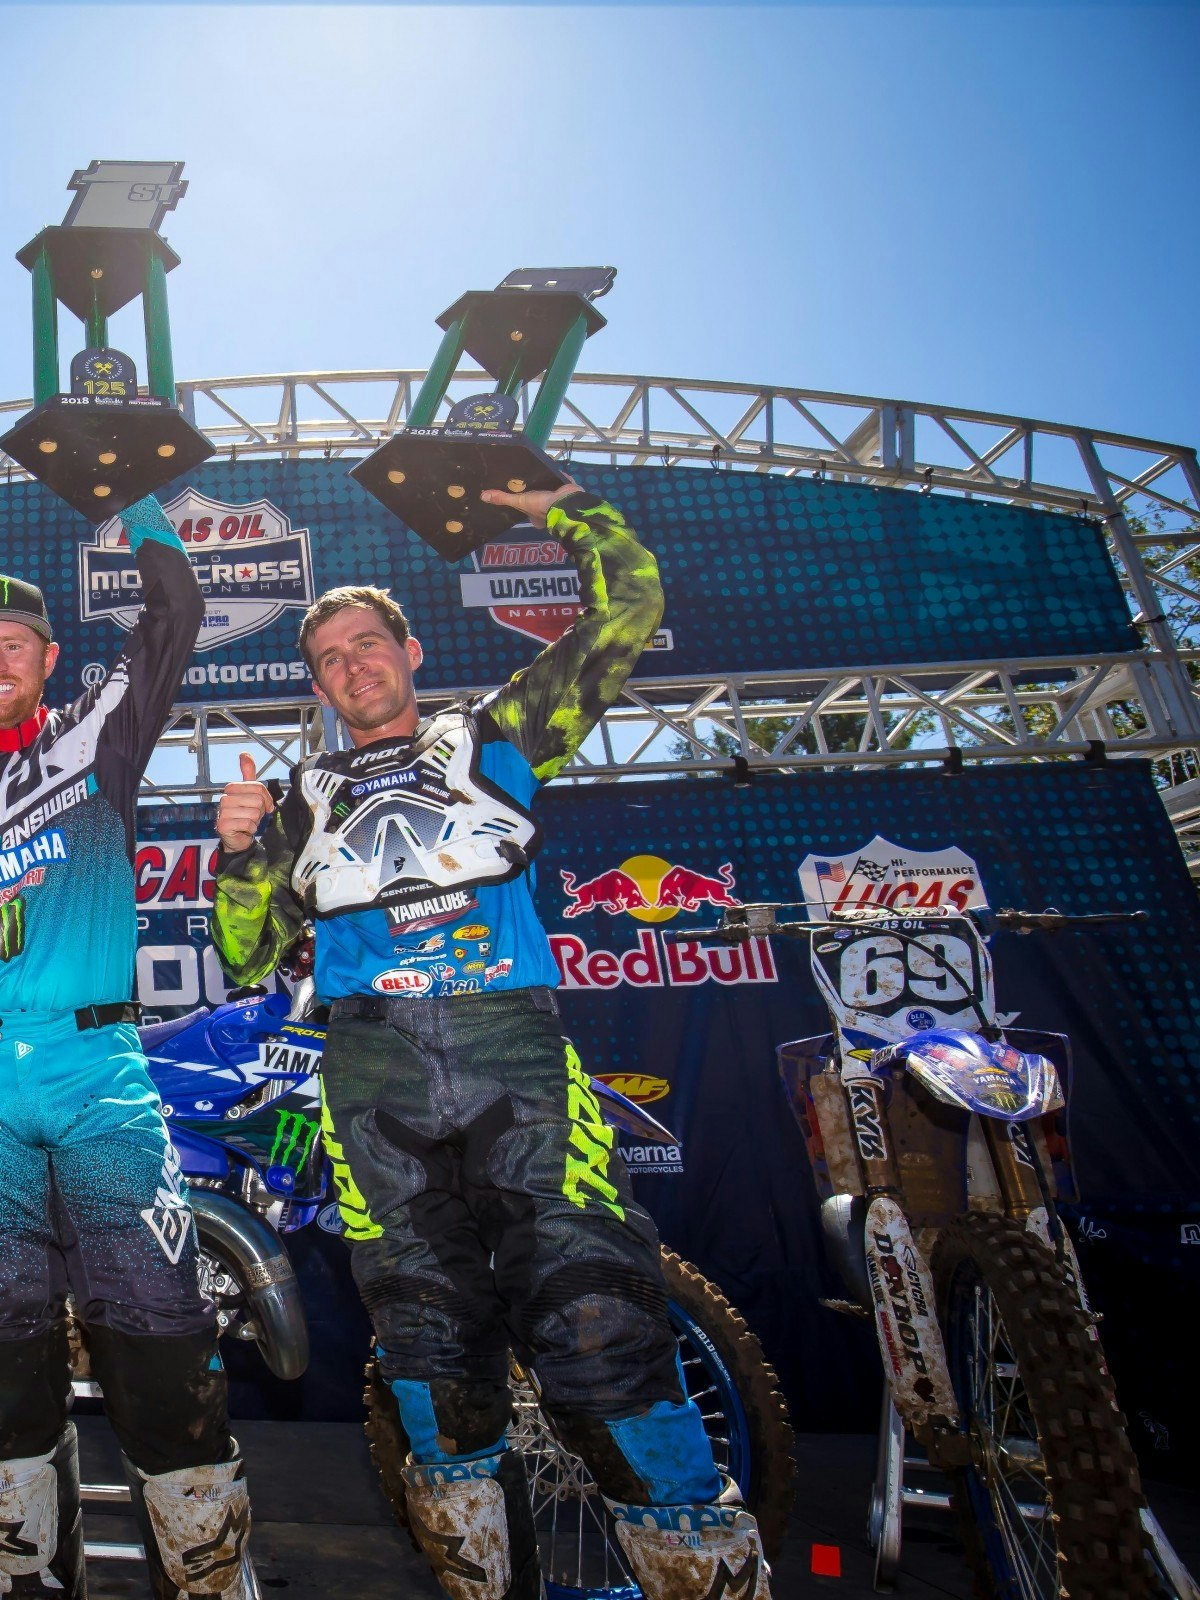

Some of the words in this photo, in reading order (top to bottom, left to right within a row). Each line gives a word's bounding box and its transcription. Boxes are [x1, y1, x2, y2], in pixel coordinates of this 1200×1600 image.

[83, 380, 126, 396] 125
[61, 397, 90, 405] 2018
[219, 514, 266, 541] OIL
[92, 559, 300, 591] MOCROSS
[366, 771, 417, 792] YAMAHA
[421, 783, 451, 799] YAMALUBE
[894, 867, 975, 878] PERFORMANCE
[380, 883, 433, 898] SENTINEL
[832, 879, 975, 915] LUCAS
[388, 890, 472, 924] YAMALUBE
[903, 920, 925, 931] OIL
[550, 931, 661, 986] Red
[666, 932, 777, 984] Bull
[840, 934, 973, 1007] 69
[381, 975, 425, 991] BELL
[281, 1025, 315, 1036] PRO
[972, 1074, 1016, 1085] YAMAHA
[906, 1269, 929, 1317] CYCRA
